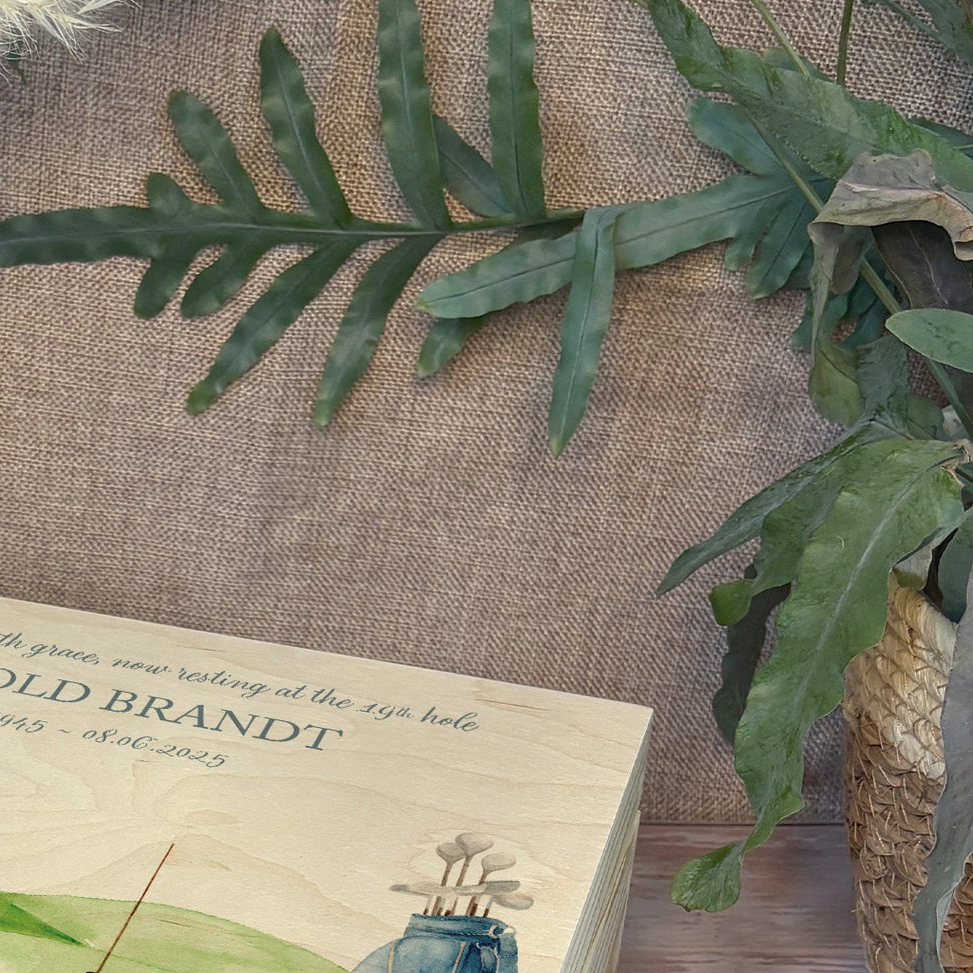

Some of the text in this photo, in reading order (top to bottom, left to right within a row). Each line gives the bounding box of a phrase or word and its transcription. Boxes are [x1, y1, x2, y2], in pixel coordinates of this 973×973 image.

[23, 641, 100, 666] grace,
[111, 656, 172, 675] now
[177, 666, 272, 698] resting
[274, 684, 308, 701] at
[309, 687, 355, 710] the
[358, 704, 414, 721] 19th
[419, 706, 480, 732] hole
[82, 728, 230, 769] 08.06.2025
[99, 688, 343, 751] BRANDT
